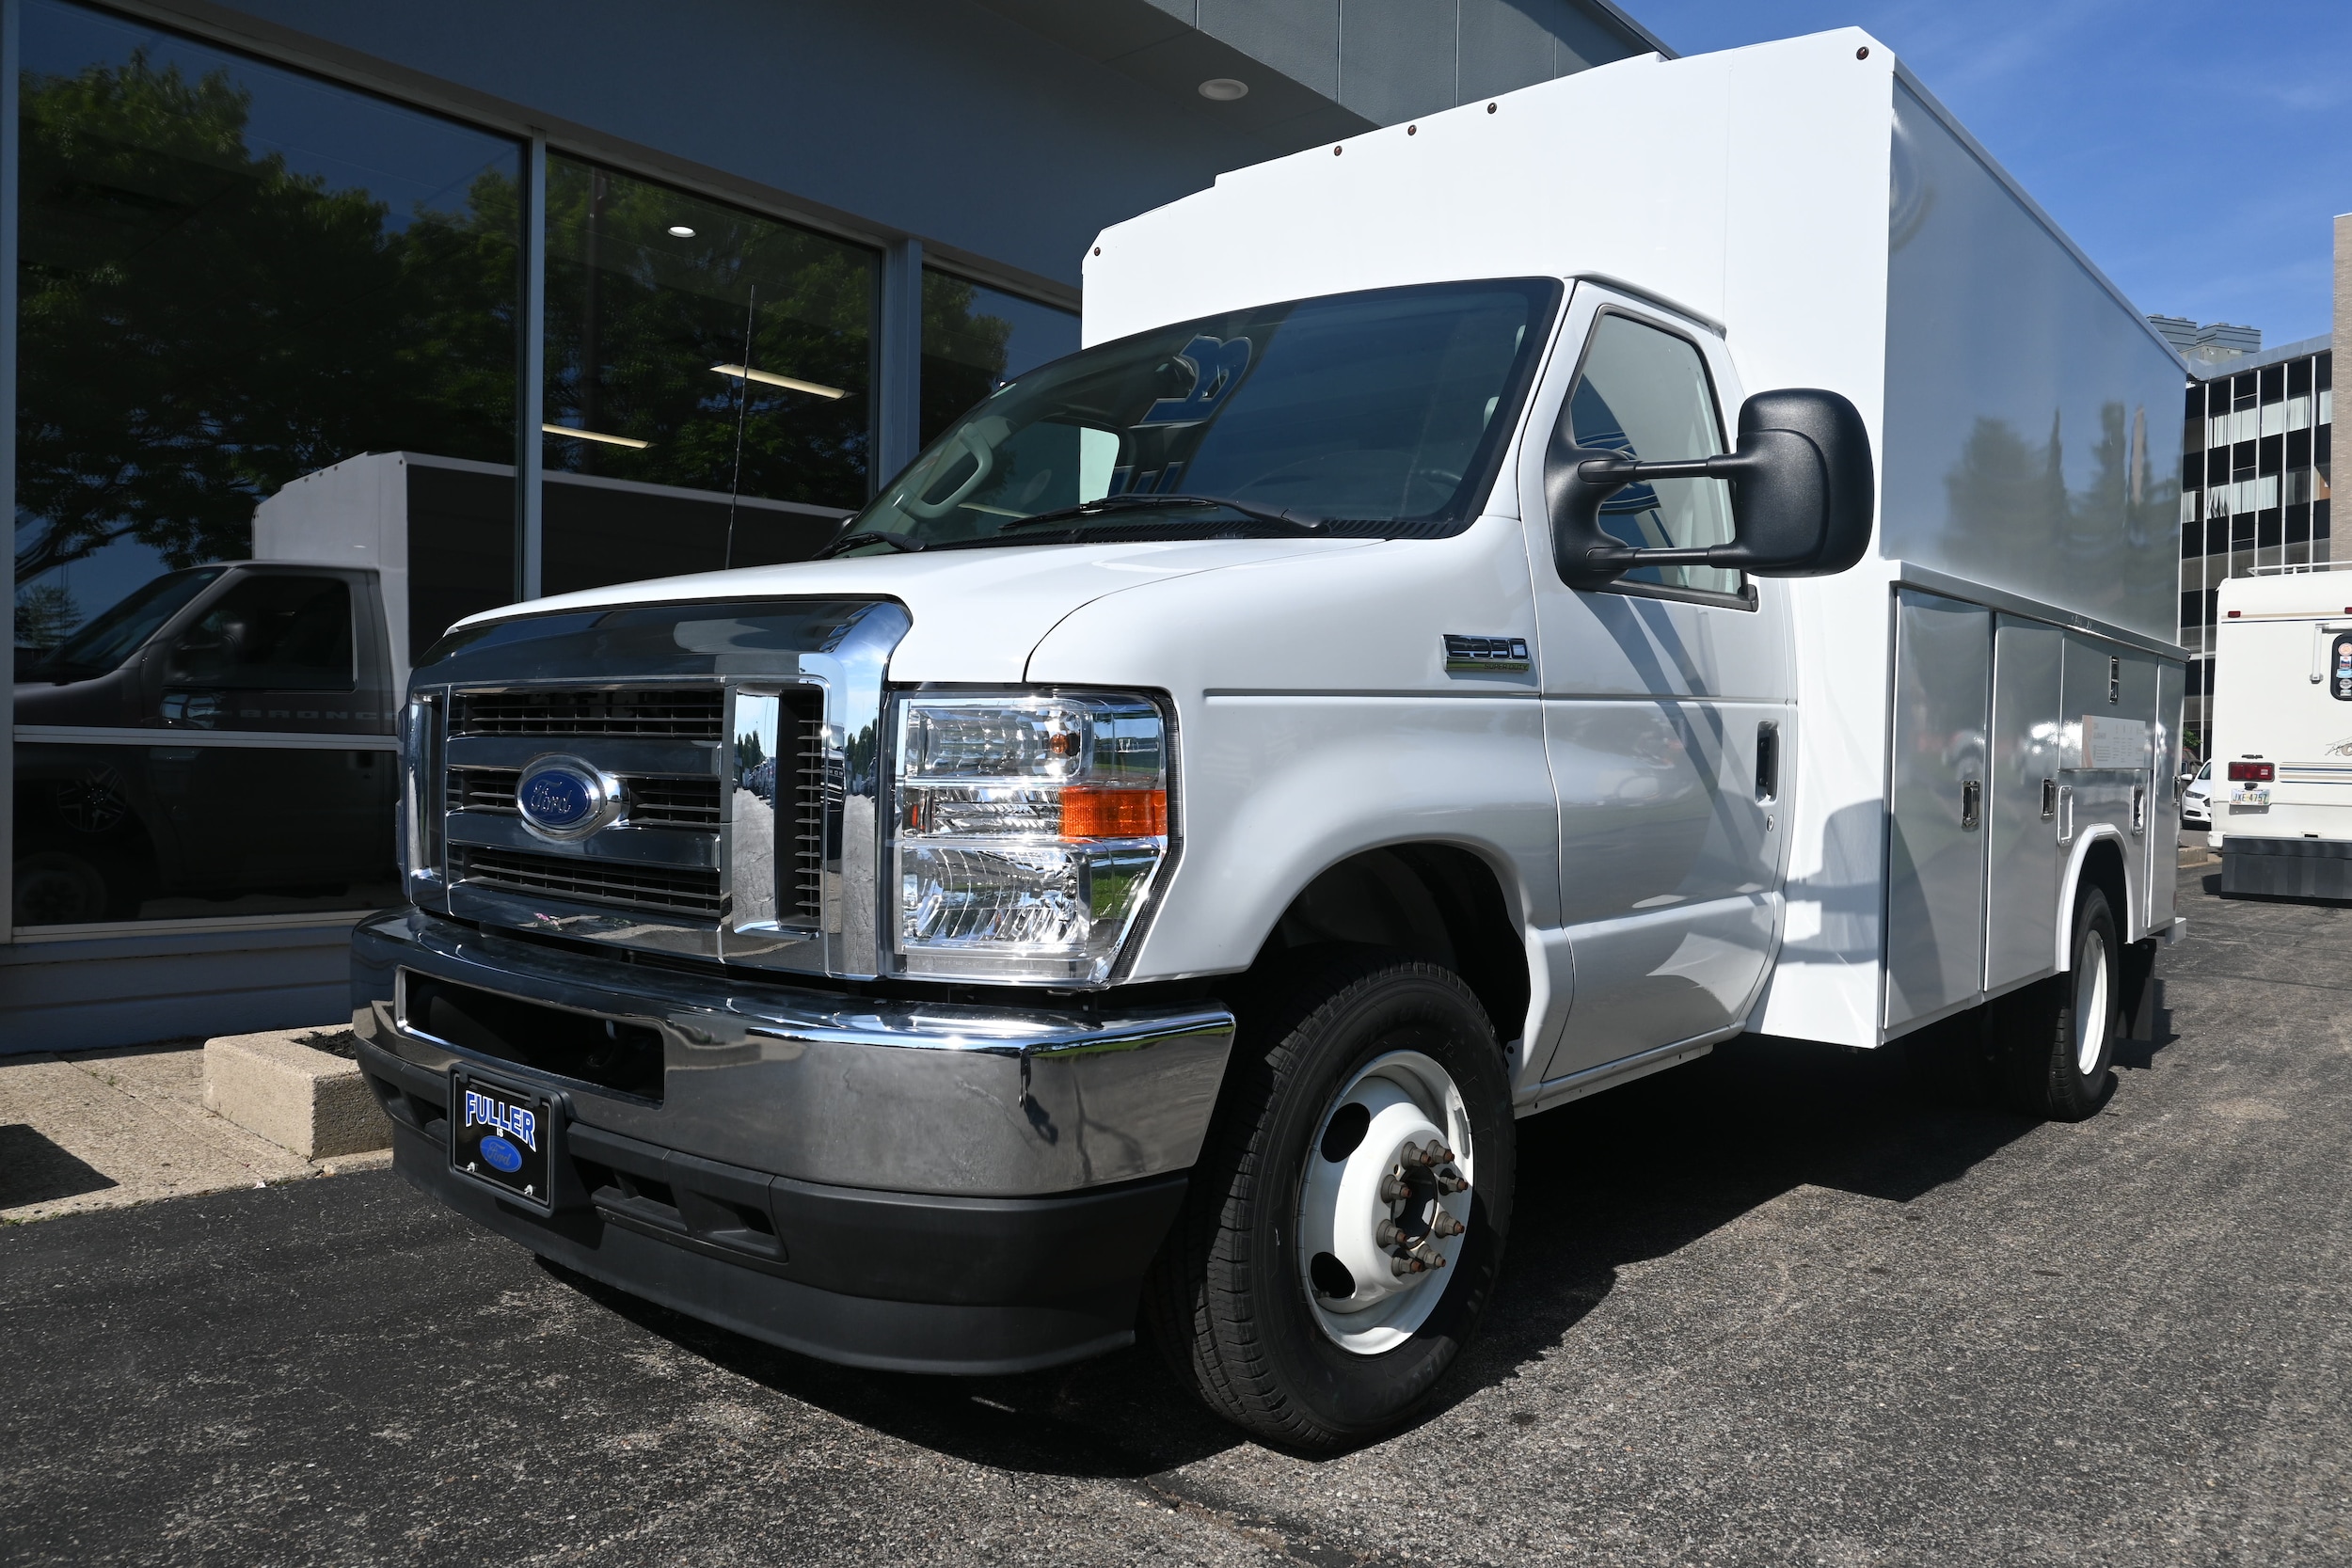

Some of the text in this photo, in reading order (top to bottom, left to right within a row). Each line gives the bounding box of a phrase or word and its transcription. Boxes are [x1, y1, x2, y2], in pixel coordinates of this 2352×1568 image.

[1484, 662, 1529, 671] SUPER DUTY
[531, 778, 572, 815] Ford
[465, 1089, 537, 1152] FULLER
[496, 1127, 504, 1137] IS
[486, 1141, 513, 1166] Ford
